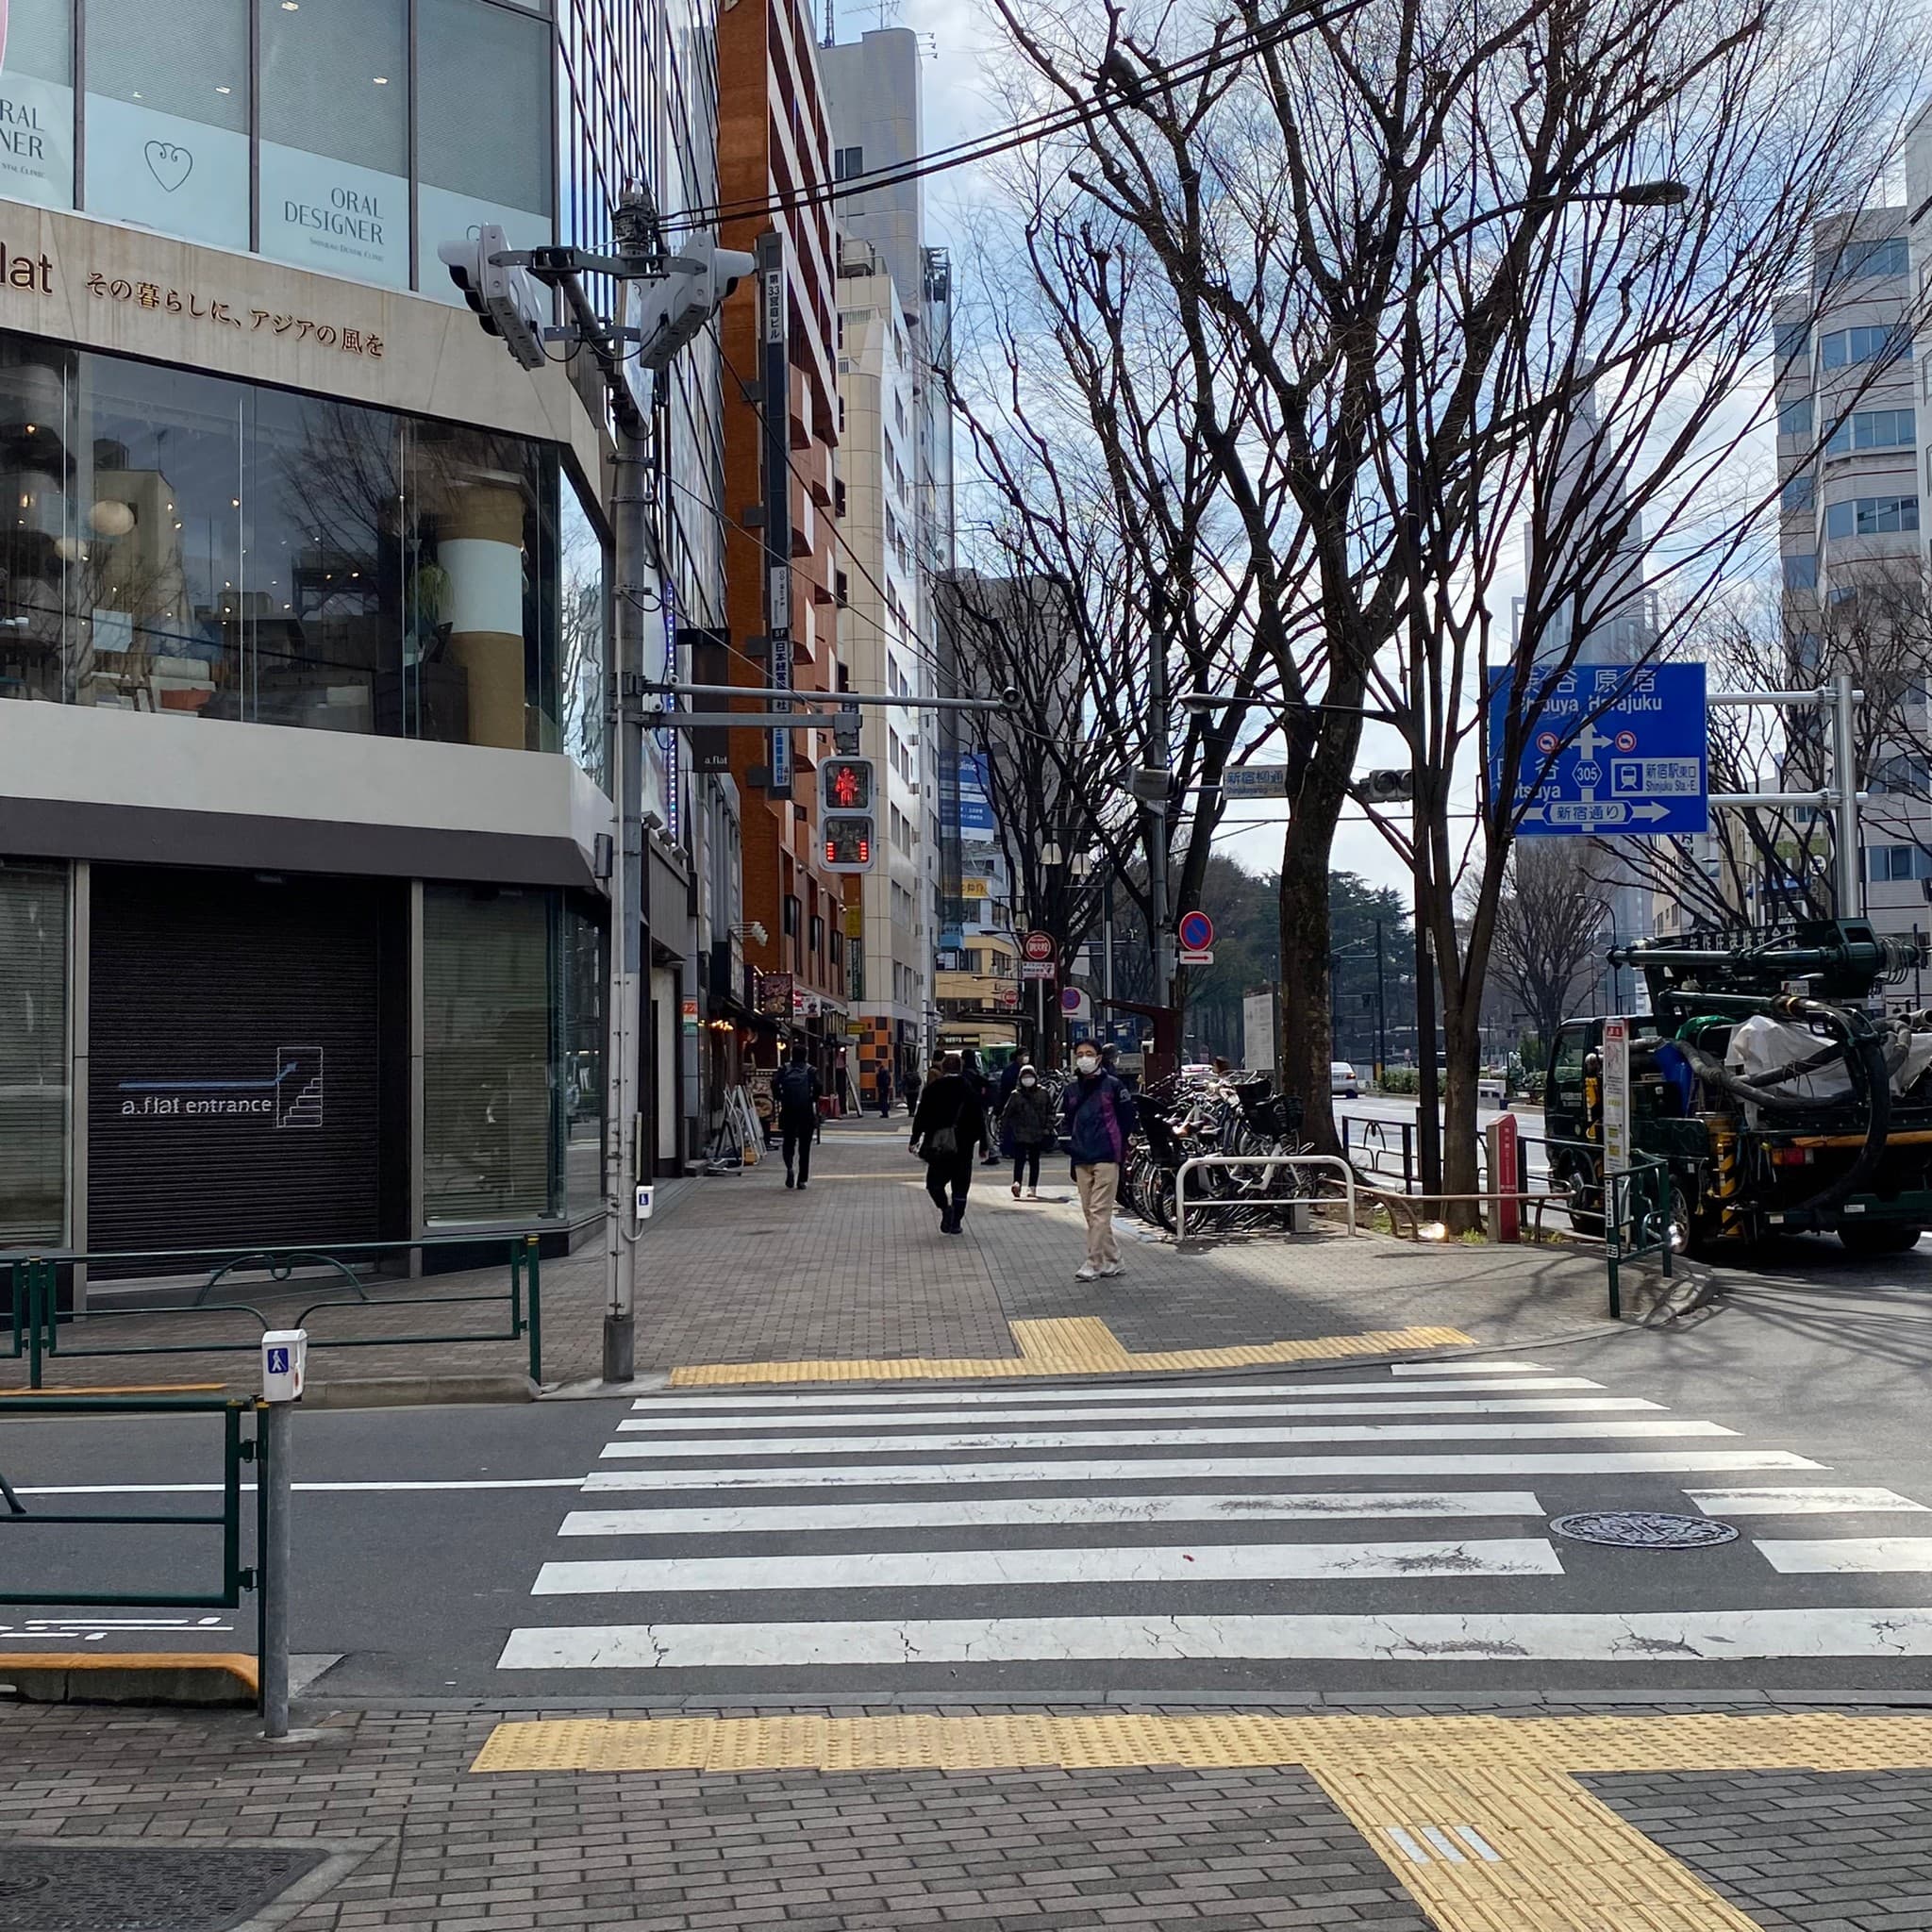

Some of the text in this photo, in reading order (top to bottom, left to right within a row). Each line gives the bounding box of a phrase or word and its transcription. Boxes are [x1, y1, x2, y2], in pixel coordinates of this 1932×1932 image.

[331, 187, 384, 220] ORAL
[285, 200, 384, 246] DESIGNER
[85, 271, 385, 358] その暮らしに、アジアの風を
[1576, 767, 1598, 781] 305
[1646, 762, 1696, 778] 新宿駅東口
[1557, 805, 1620, 821] 新宿通り
[121, 1096, 273, 1115] a.flat entrance
